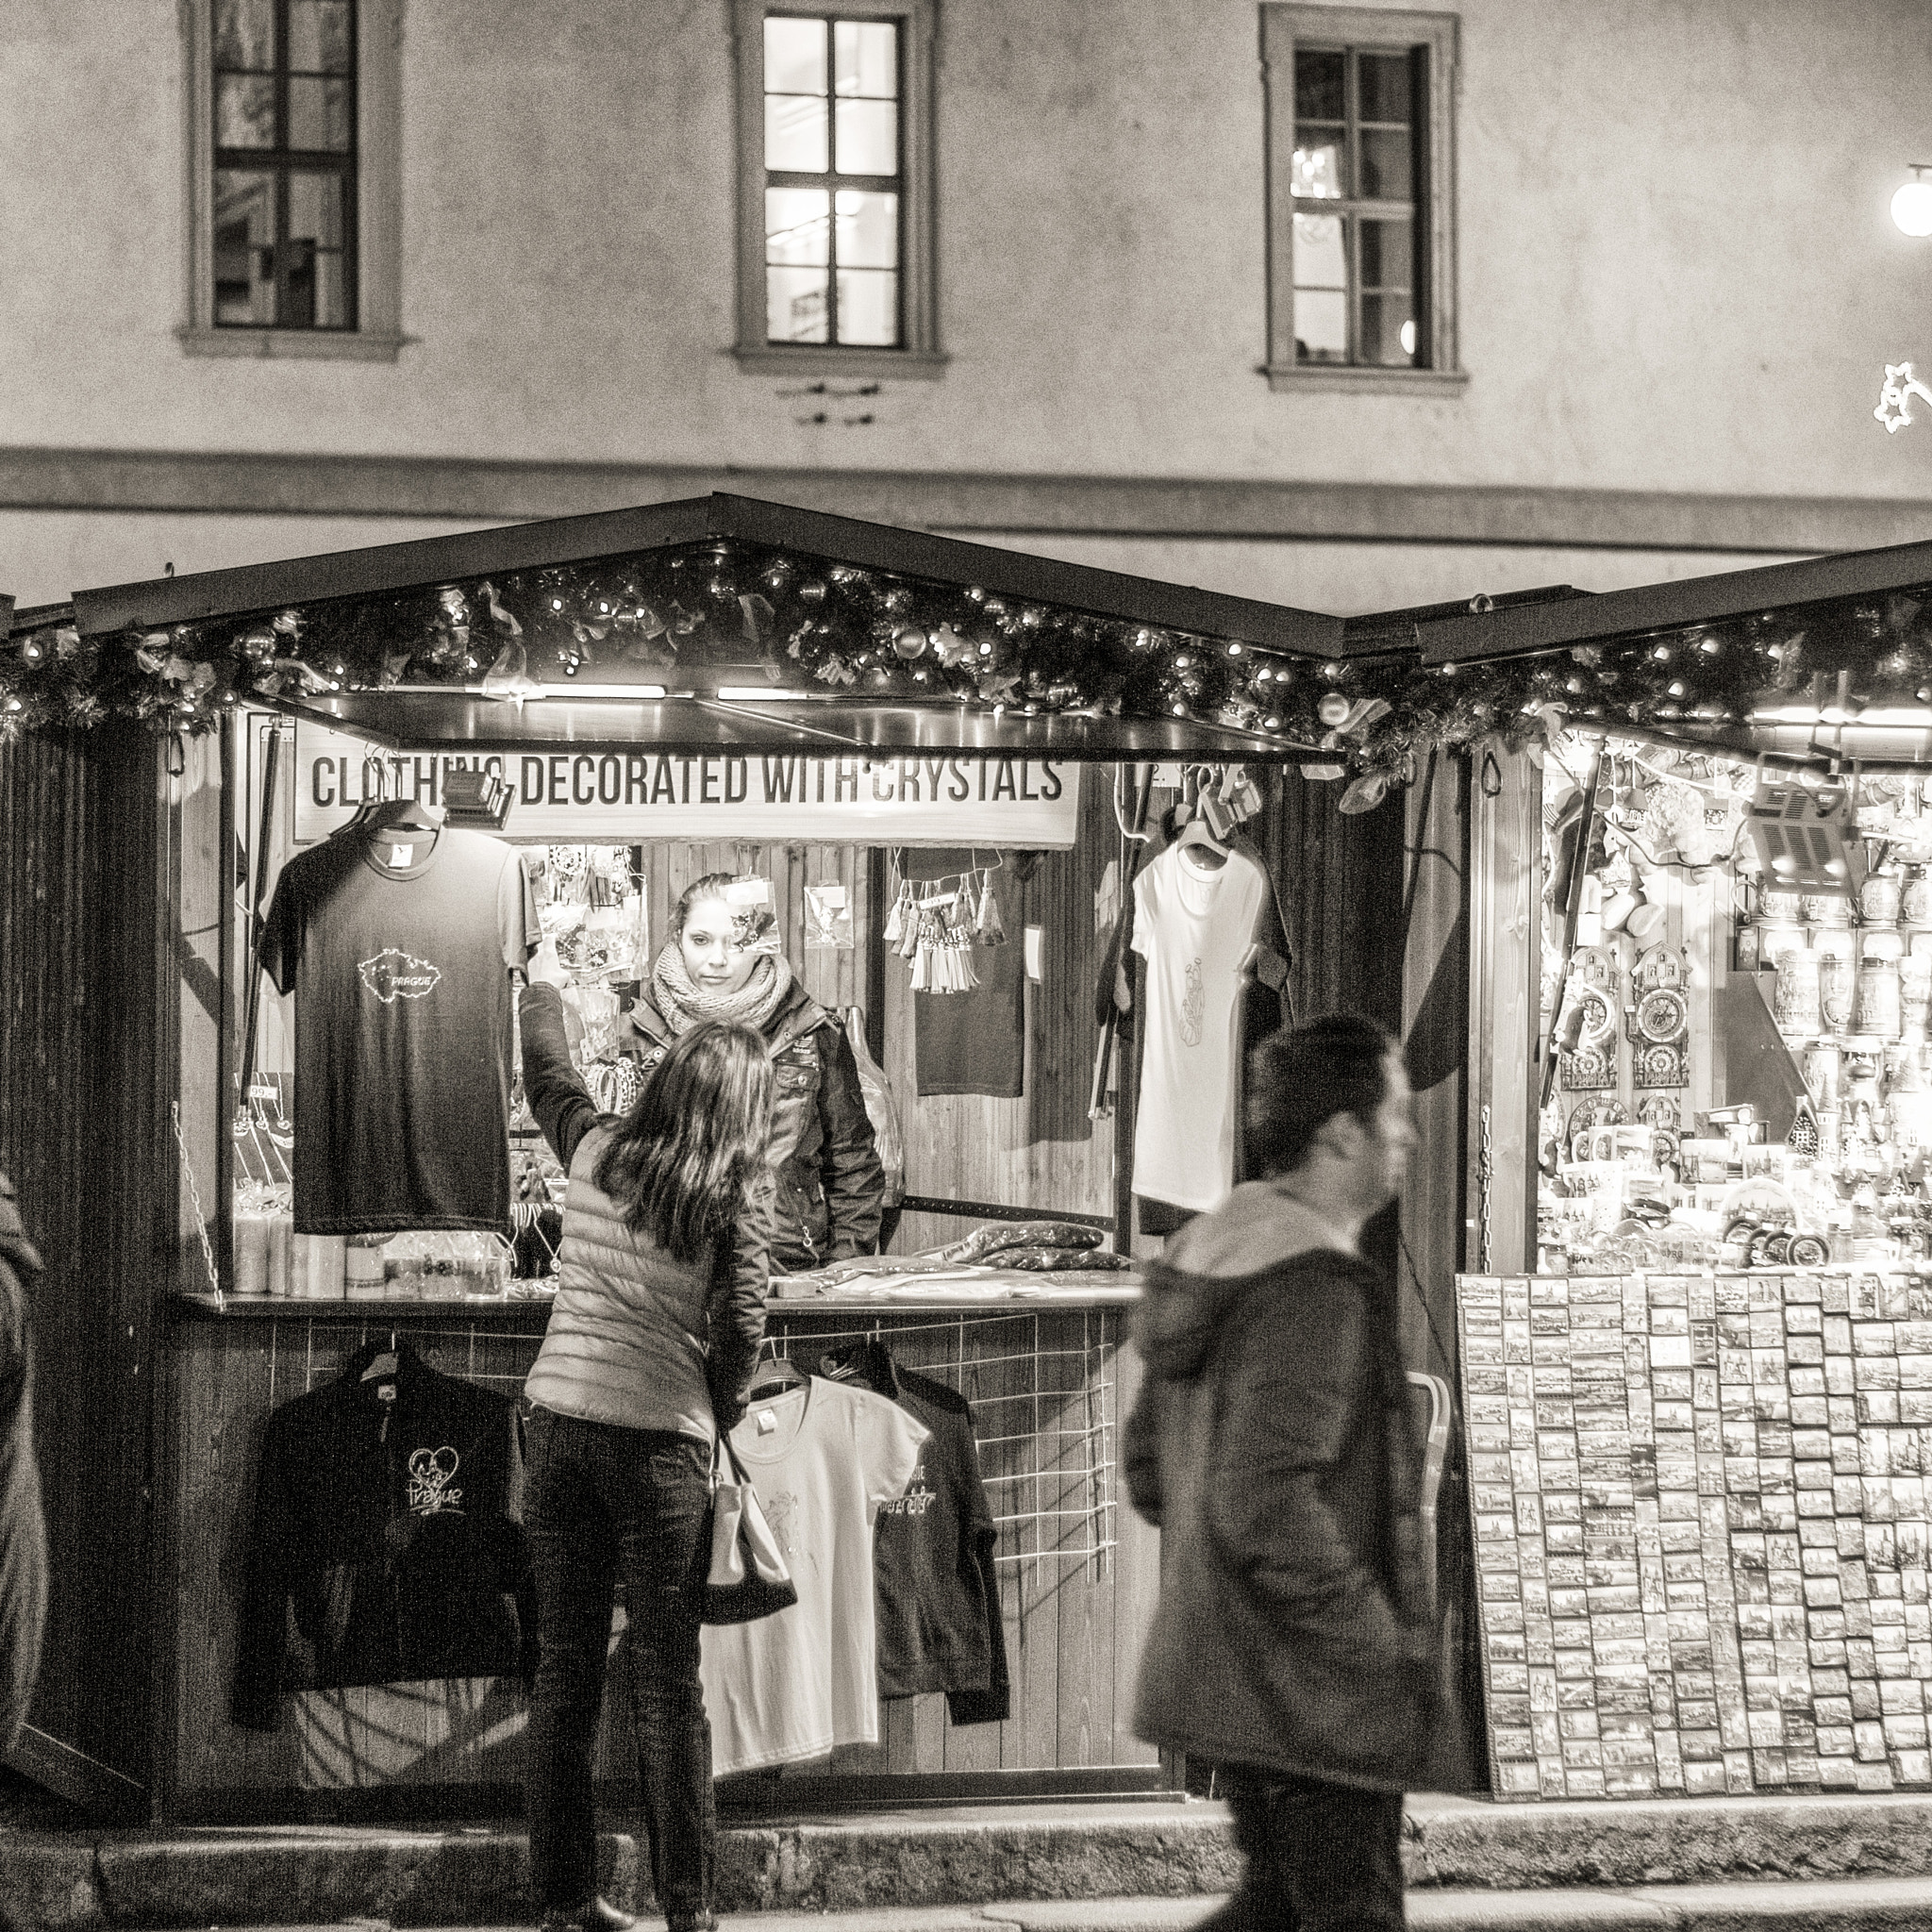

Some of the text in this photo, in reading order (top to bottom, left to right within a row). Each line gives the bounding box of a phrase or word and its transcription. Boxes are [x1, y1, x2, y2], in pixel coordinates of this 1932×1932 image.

[312, 756, 1063, 807] CLOTH DECORATED WITH CRYSTALS
[391, 976, 432, 986] PRAGUE
[406, 1478, 463, 1511] Prague
